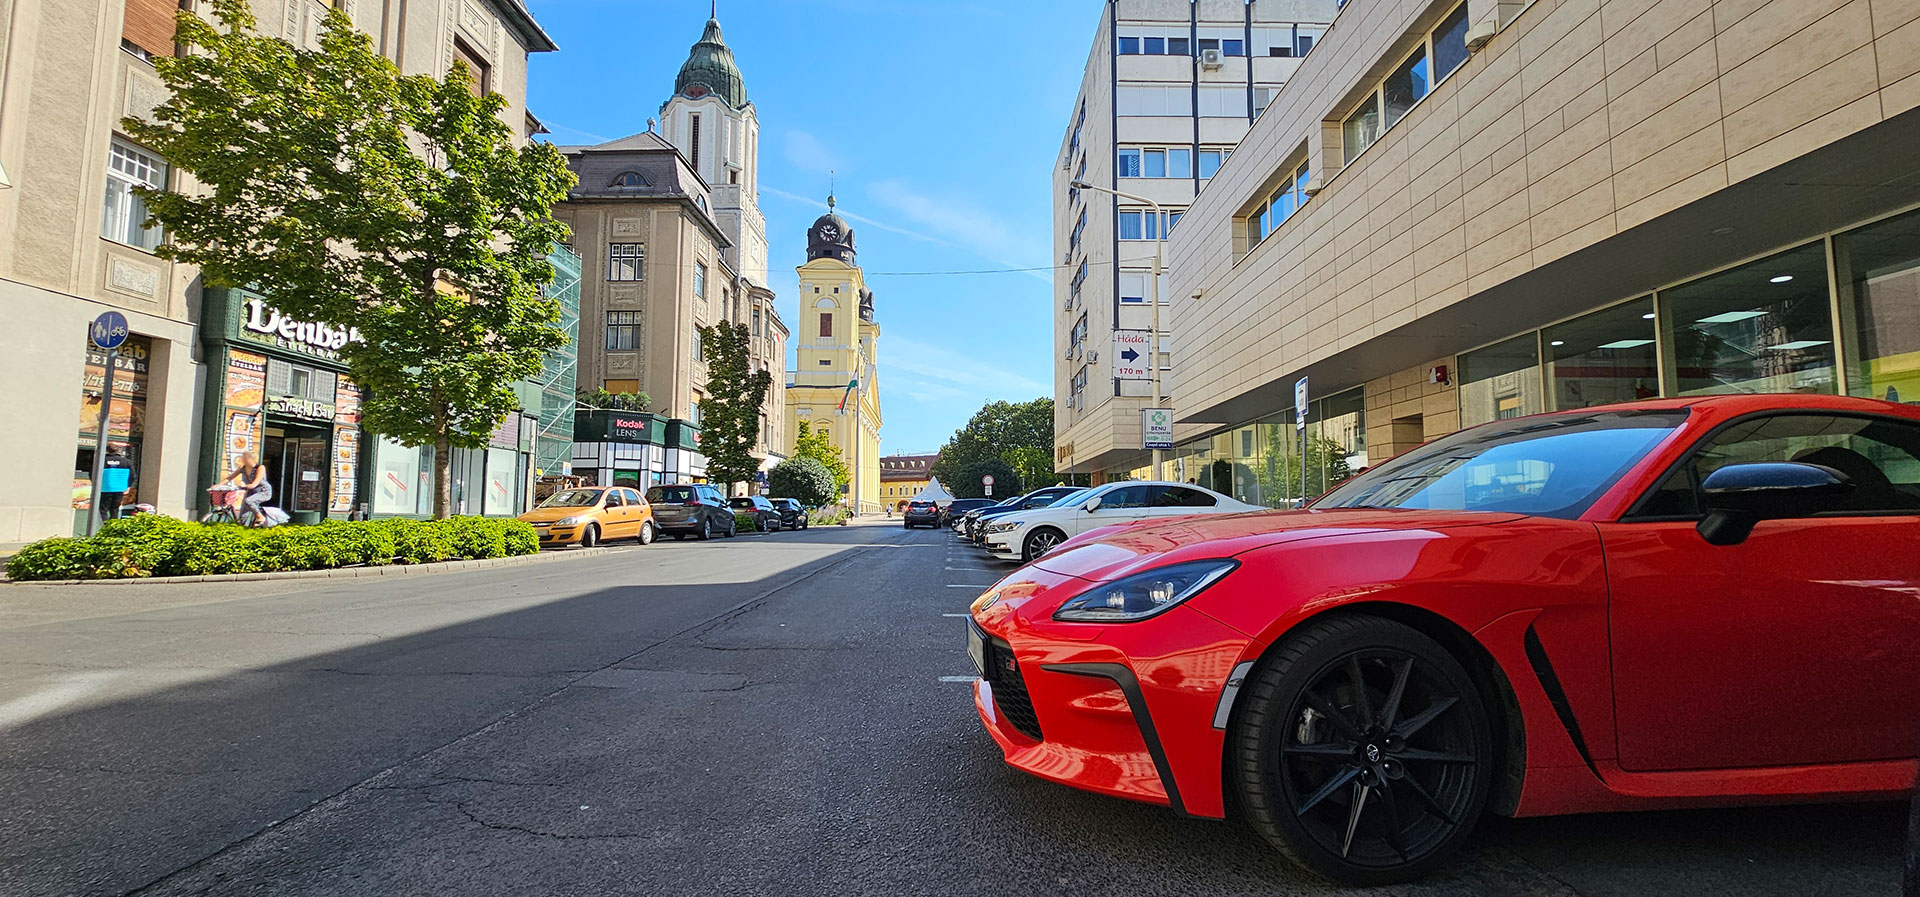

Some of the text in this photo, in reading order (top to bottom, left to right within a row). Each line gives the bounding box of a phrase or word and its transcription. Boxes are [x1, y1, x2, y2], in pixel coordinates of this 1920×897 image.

[1117, 335, 1144, 343] Háda
[1119, 367, 1134, 375] 170
[616, 419, 645, 429] Kodak
[616, 428, 637, 437] LENS
